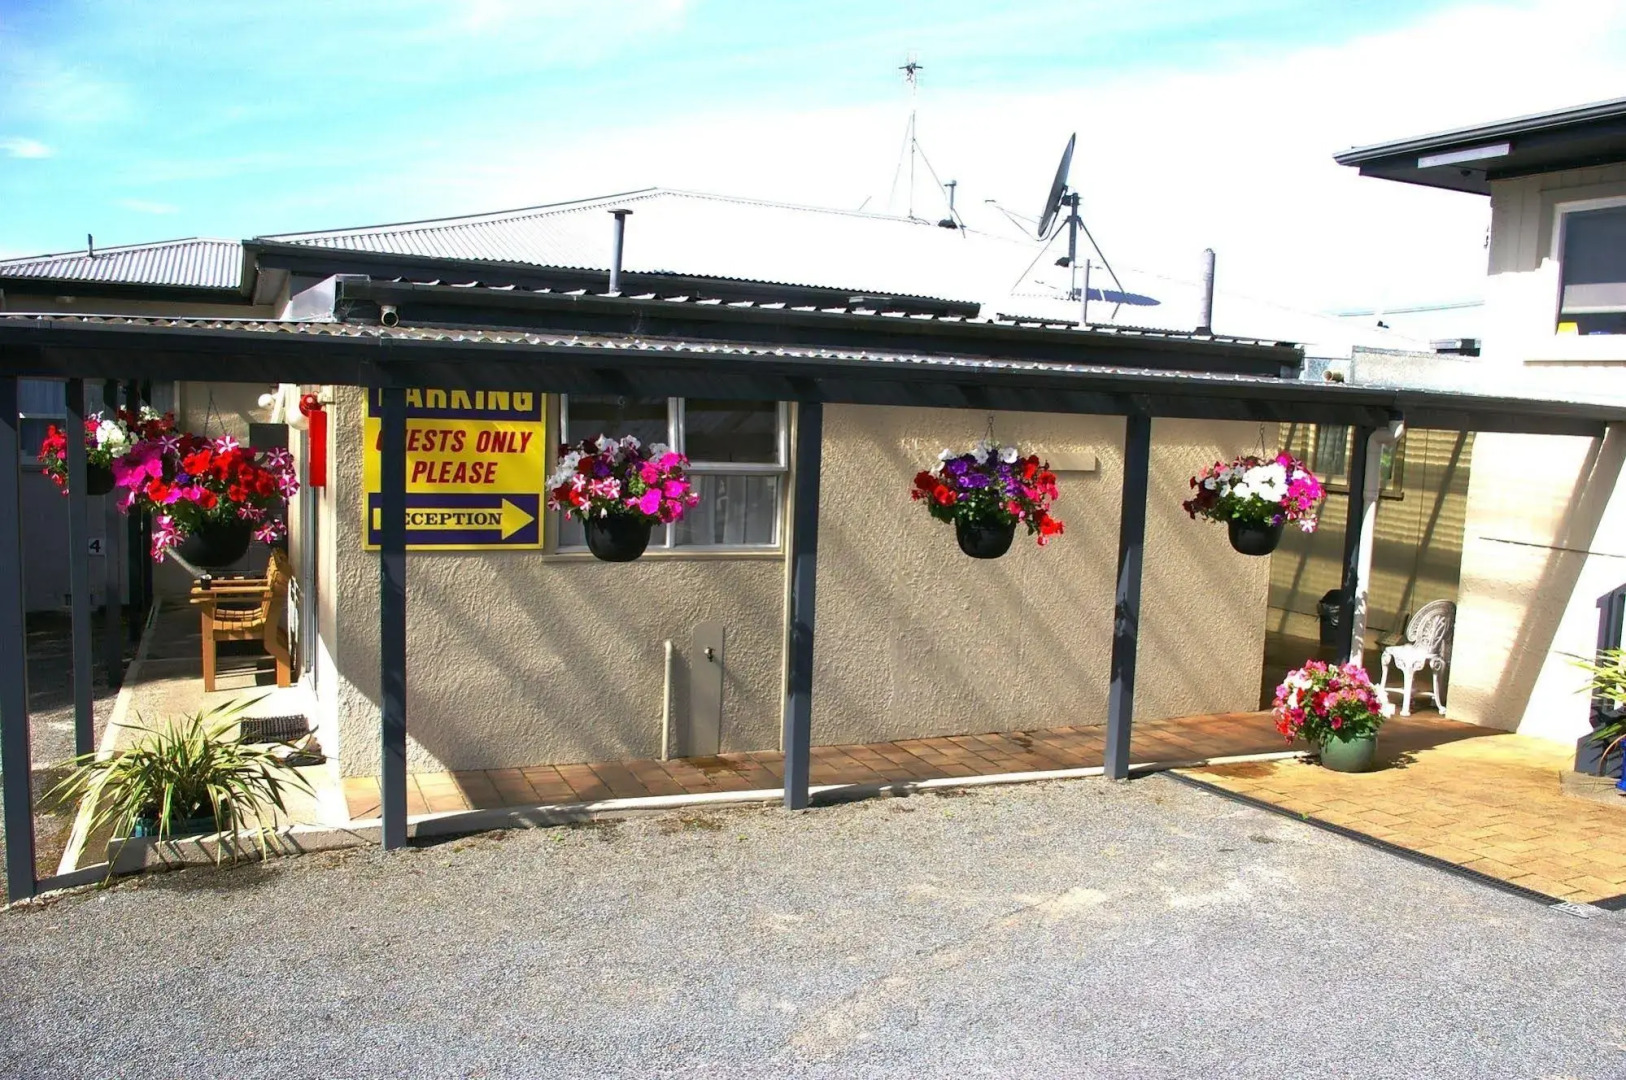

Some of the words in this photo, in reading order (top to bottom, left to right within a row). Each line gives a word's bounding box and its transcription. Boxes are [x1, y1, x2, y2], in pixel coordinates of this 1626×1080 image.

[378, 387, 533, 412] ARKING
[376, 429, 466, 452] ESTS
[476, 430, 533, 453] ONLY
[411, 461, 498, 484] PLEASE
[404, 512, 502, 525] CEPTION
[89, 539, 101, 553] 4
